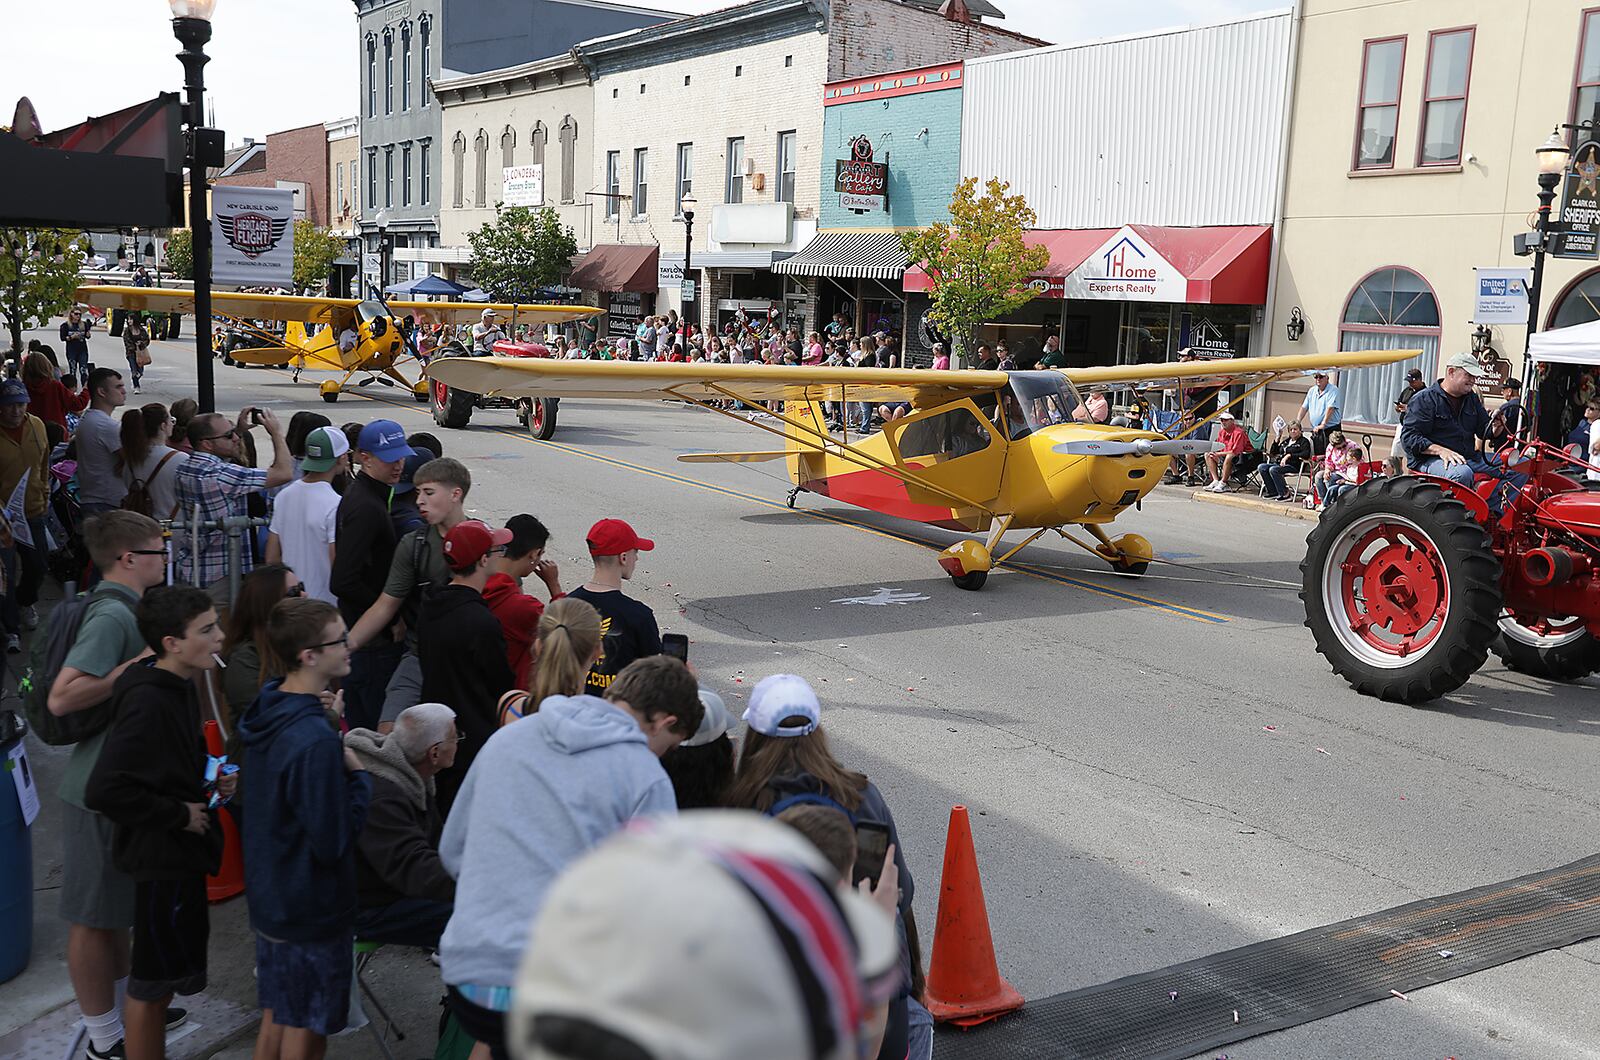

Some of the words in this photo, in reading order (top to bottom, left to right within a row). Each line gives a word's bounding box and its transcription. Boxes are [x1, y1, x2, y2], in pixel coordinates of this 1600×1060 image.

[852, 162, 881, 176] ART
[837, 171, 883, 189] Gallery
[1572, 198, 1588, 207] CLARK
[237, 220, 268, 231] HERITAGE
[1572, 223, 1590, 231] OFFICE
[238, 231, 269, 244] FLIGHT
[1574, 236, 1596, 244] CARLISLE
[1112, 246, 1157, 278] Home
[1089, 283, 1124, 294] Experts
[1126, 284, 1157, 295] Realty
[1482, 280, 1506, 288] United
[1491, 286, 1505, 295] Way
[610, 304, 622, 314] JUNK
[1195, 325, 1229, 349] Home
[1213, 350, 1235, 359] Realty
